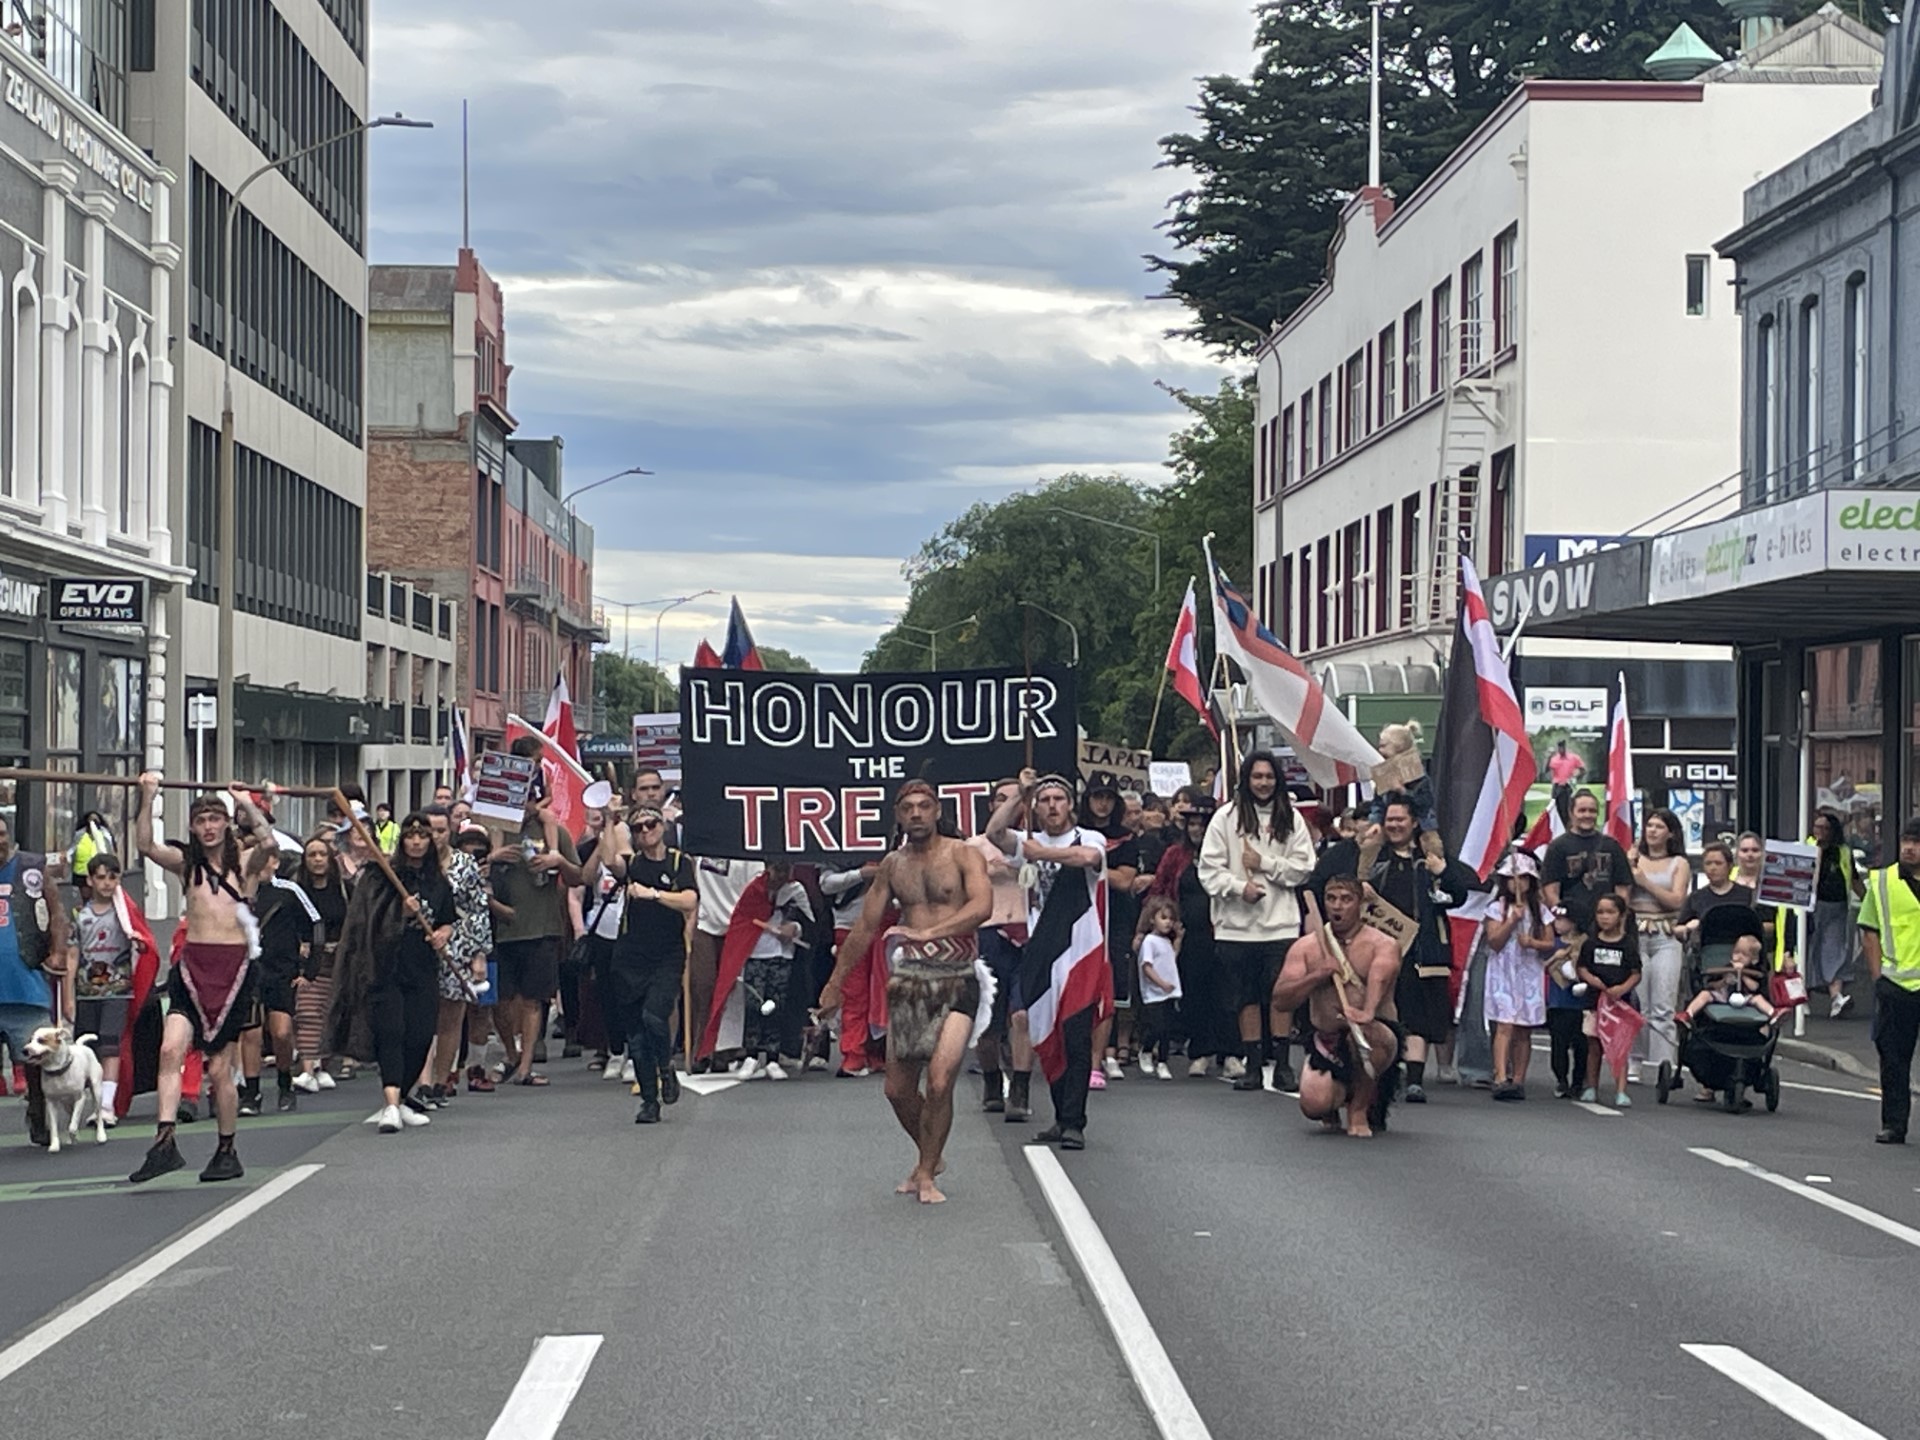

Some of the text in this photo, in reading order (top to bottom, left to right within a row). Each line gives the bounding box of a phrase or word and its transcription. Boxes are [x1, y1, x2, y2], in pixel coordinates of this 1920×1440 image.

[5, 67, 61, 140] ZEALAND
[1766, 526, 1812, 562] e-bikes
[0, 577, 41, 616] GIANT
[60, 583, 134, 604] EVO
[1492, 562, 1595, 626] SNOW
[60, 606, 134, 619] OPEN 7 DAYS
[689, 677, 1057, 749] HONOUR
[1549, 699, 1603, 712] GOLF
[849, 756, 906, 780] THE
[724, 781, 1005, 852] TRET
